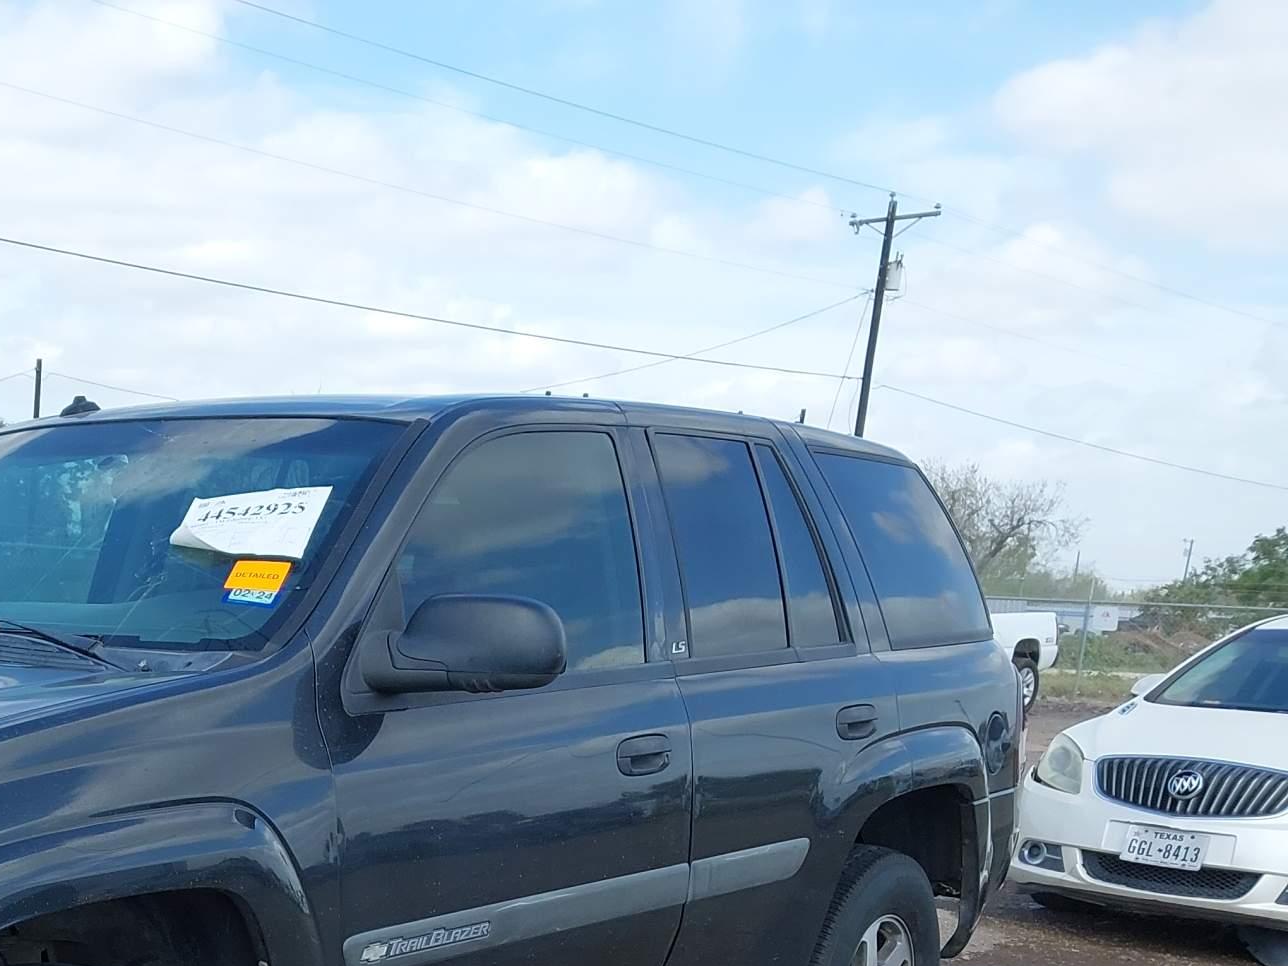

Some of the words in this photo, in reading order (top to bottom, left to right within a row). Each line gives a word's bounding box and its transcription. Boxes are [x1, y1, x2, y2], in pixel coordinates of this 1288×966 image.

[197, 502, 306, 522] 44542925
[235, 572, 280, 580] DETAILED
[233, 588, 251, 597] 02
[672, 641, 685, 654] LS
[1154, 831, 1185, 841] TEXAS
